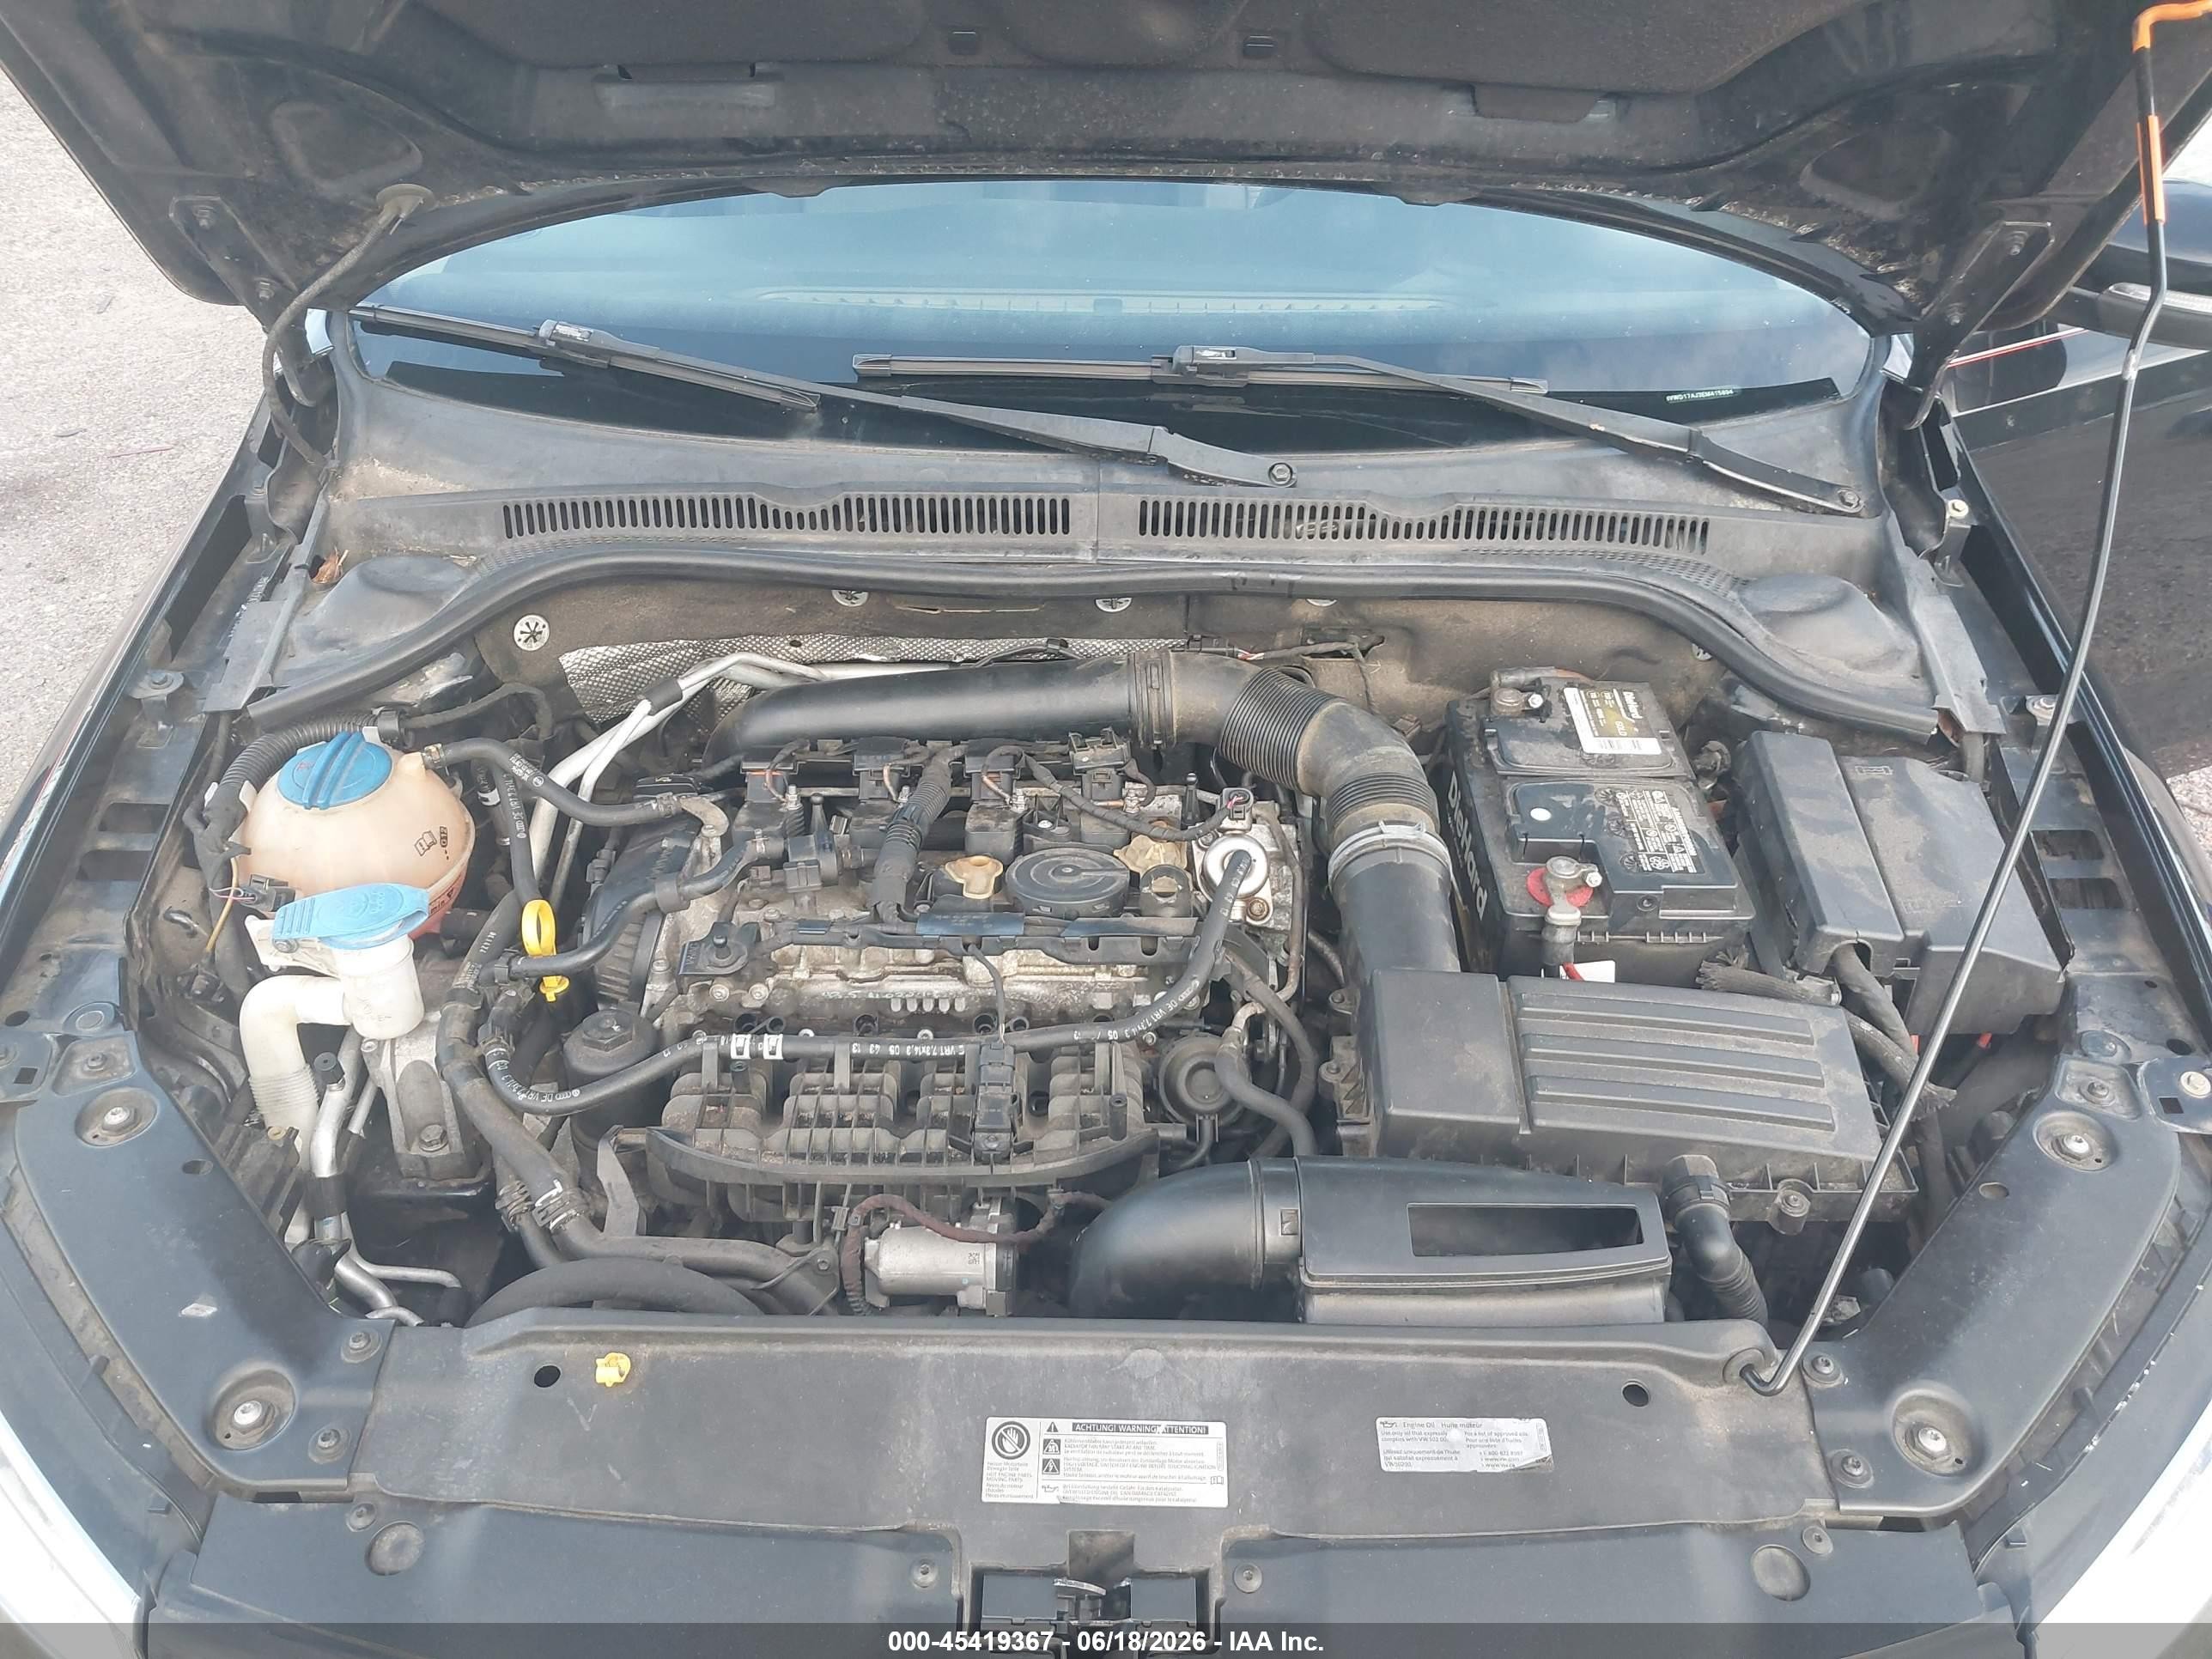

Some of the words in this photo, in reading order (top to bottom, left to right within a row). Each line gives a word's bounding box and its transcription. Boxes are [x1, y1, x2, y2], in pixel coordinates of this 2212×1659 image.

[1449, 771, 1488, 921] DieHard
[431, 900, 445, 914] min
[1166, 999, 1179, 1012] DE
[1151, 1007, 1168, 1024] VRT
[852, 1042, 861, 1054] 13
[869, 1043, 880, 1054] 43
[889, 1044, 900, 1054] 05
[940, 1045, 957, 1055] VRT
[541, 1093, 554, 1103] DE
